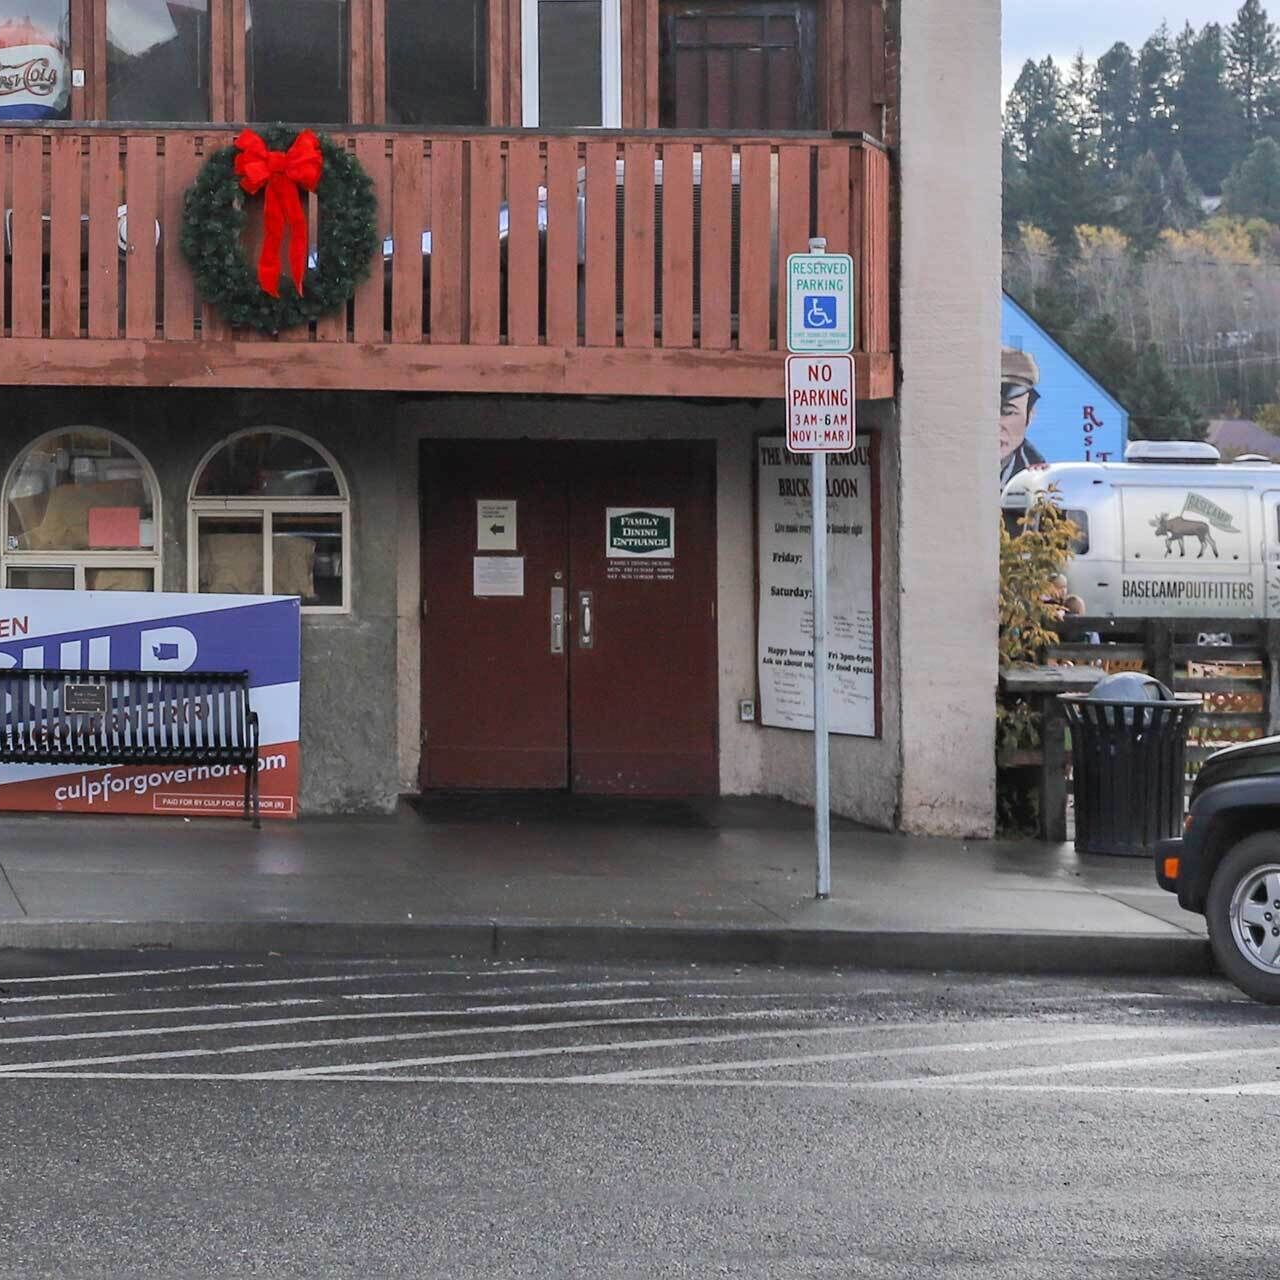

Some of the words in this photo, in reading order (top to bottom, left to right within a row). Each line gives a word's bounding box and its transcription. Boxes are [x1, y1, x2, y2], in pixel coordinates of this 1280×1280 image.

[792, 262, 848, 275] RESERVED
[796, 279, 844, 291] PARKING
[808, 364, 832, 382] NO
[792, 389, 848, 407] PARKING
[761, 447, 781, 466] THE
[782, 449, 812, 466] WORL
[826, 448, 871, 466] AMOU
[778, 478, 810, 497] BRICK
[825, 478, 858, 498] LOON
[621, 516, 659, 526] FAMILY
[622, 528, 658, 536] DINING
[612, 537, 668, 546] ENTRANCE
[772, 552, 803, 564] Friday:
[770, 586, 813, 599] Saturday:
[767, 646, 787, 656] Happy
[789, 648, 806, 656] hour
[828, 651, 838, 659] Fri
[762, 657, 773, 665] Ask
[783, 658, 803, 667] about
[836, 663, 851, 671] food
[852, 666, 873, 675] specia
[162, 798, 178, 806] PAID
[179, 798, 193, 806] FOR
[204, 799, 220, 807] CULP
[221, 799, 235, 807] FOR
